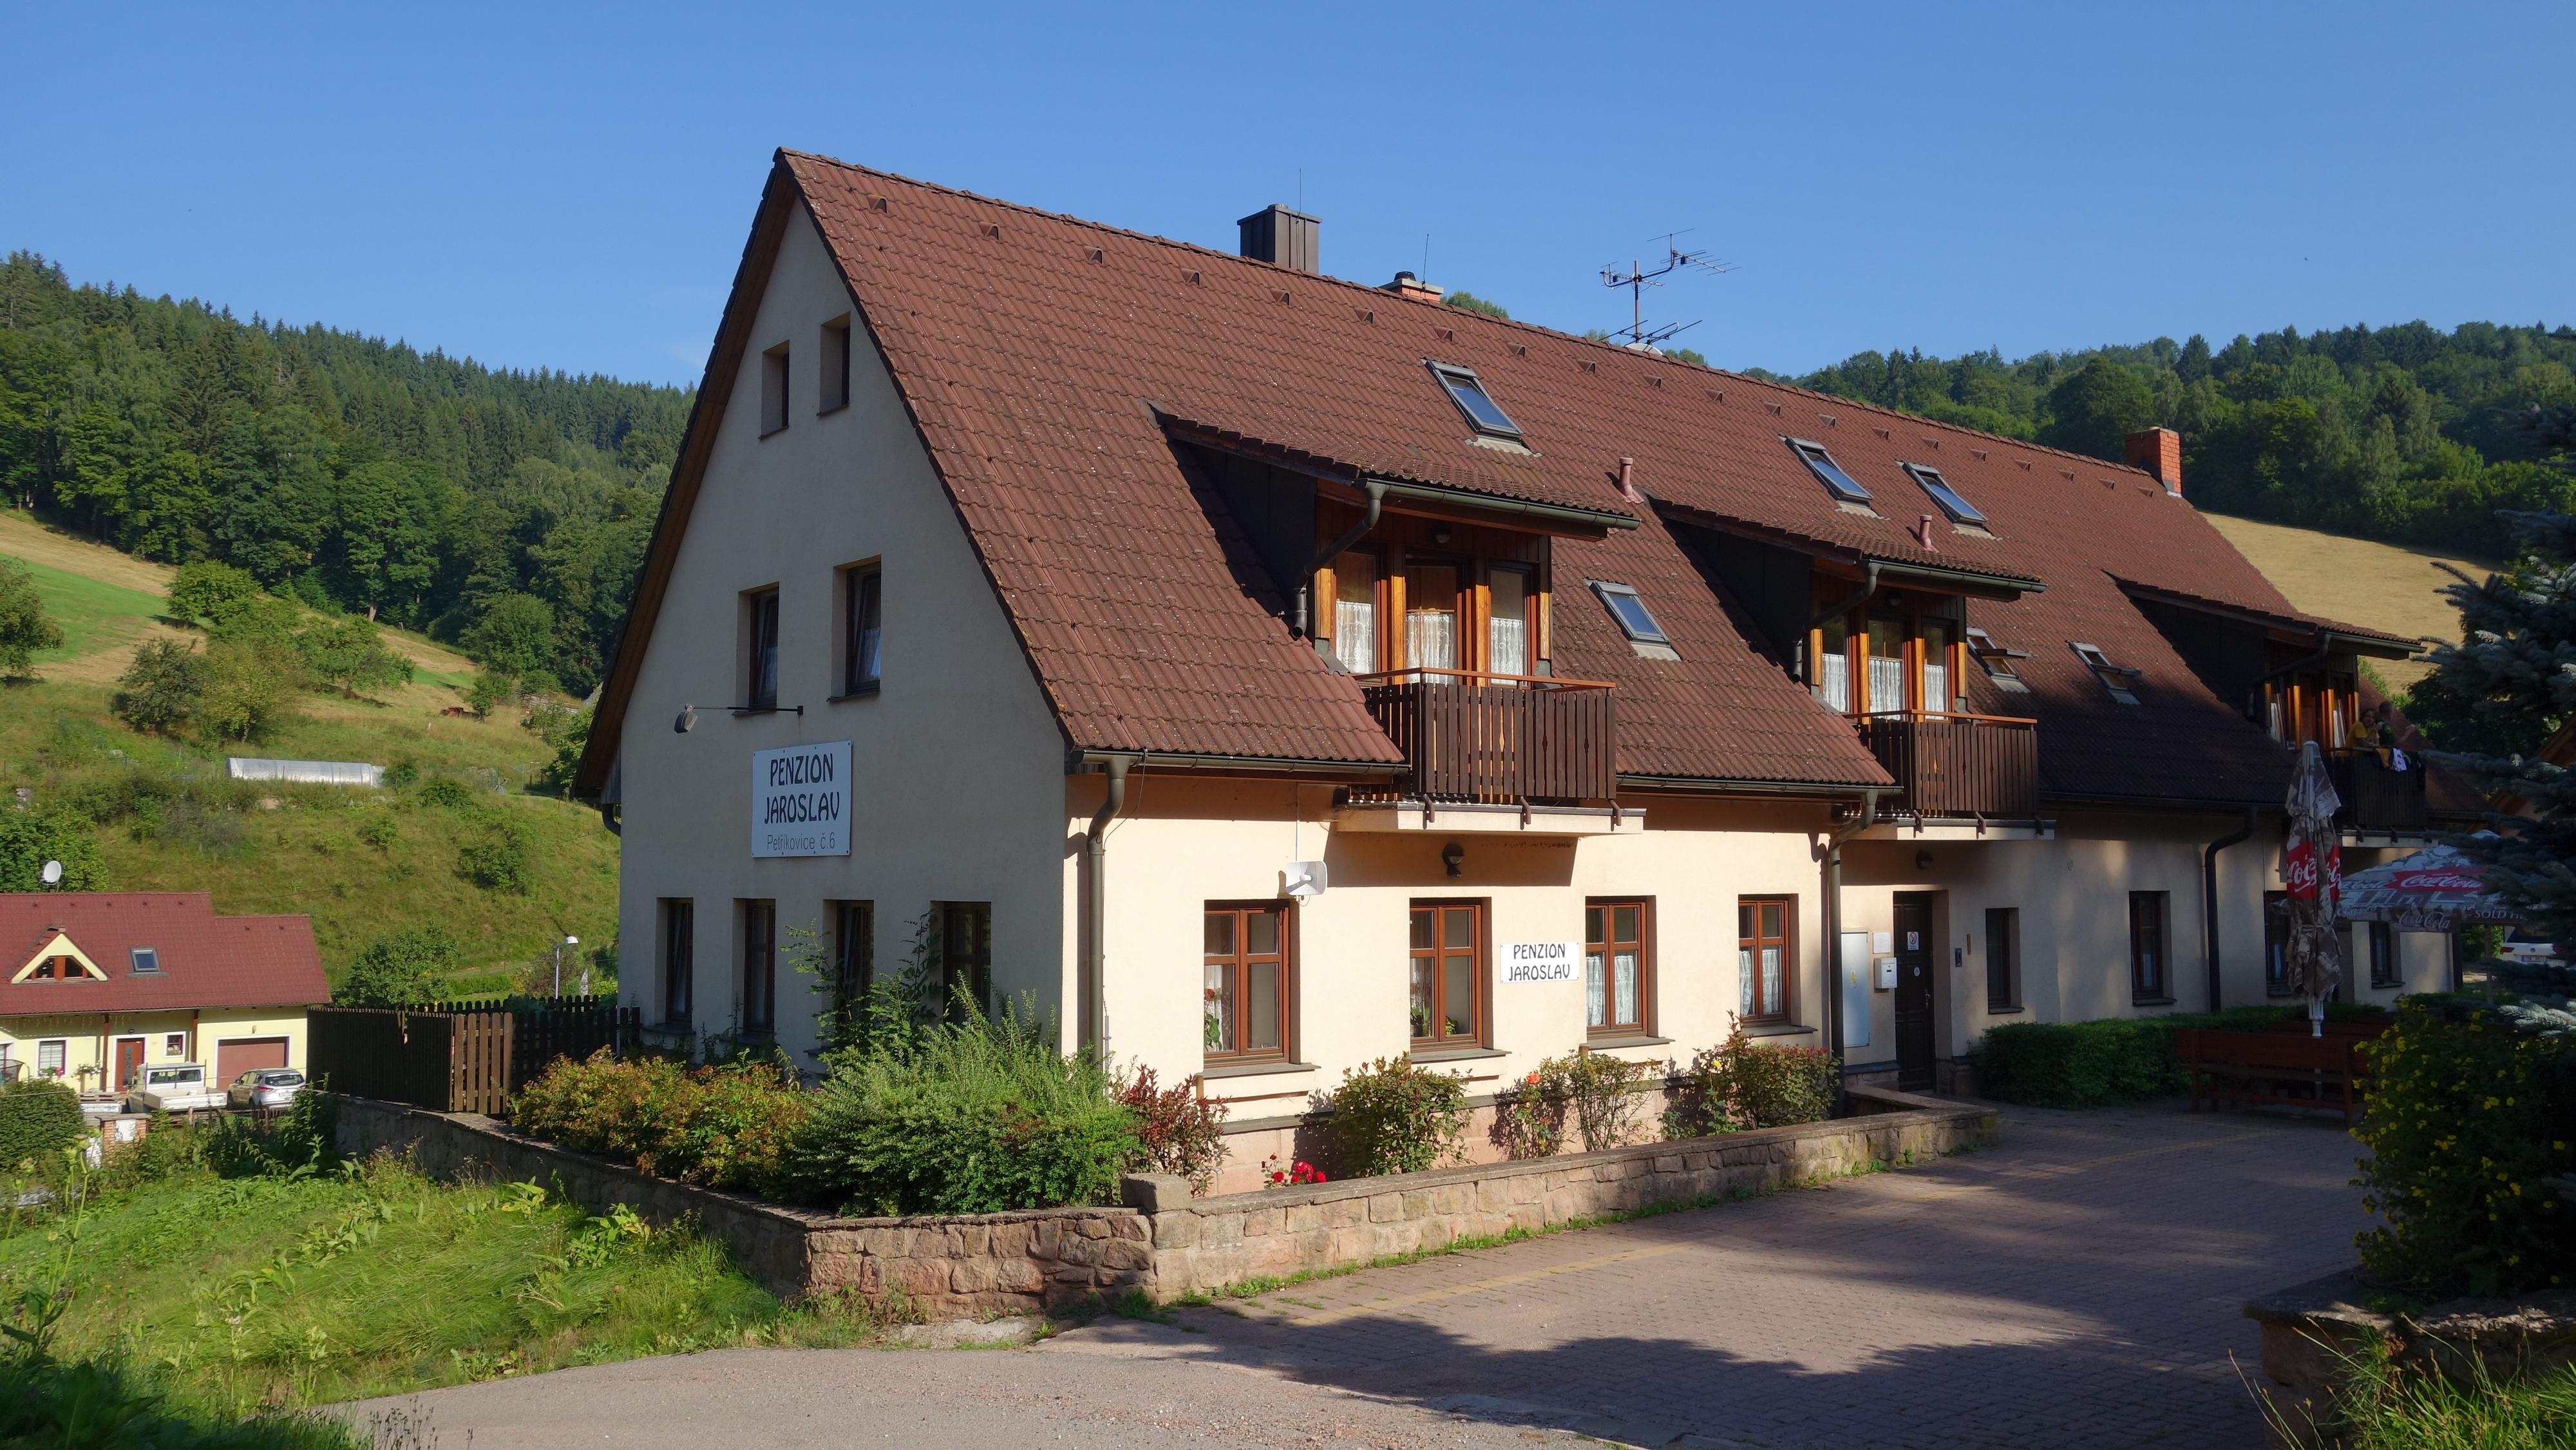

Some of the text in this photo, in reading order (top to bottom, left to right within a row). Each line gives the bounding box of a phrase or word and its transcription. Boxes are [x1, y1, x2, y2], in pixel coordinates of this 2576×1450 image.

[770, 752, 833, 787] PENZION
[764, 791, 840, 824] JAROSLAV
[2474, 909, 2506, 919] SOLD
[1513, 943, 1566, 960] PENZION
[1508, 964, 1570, 982] JAROSLAV
